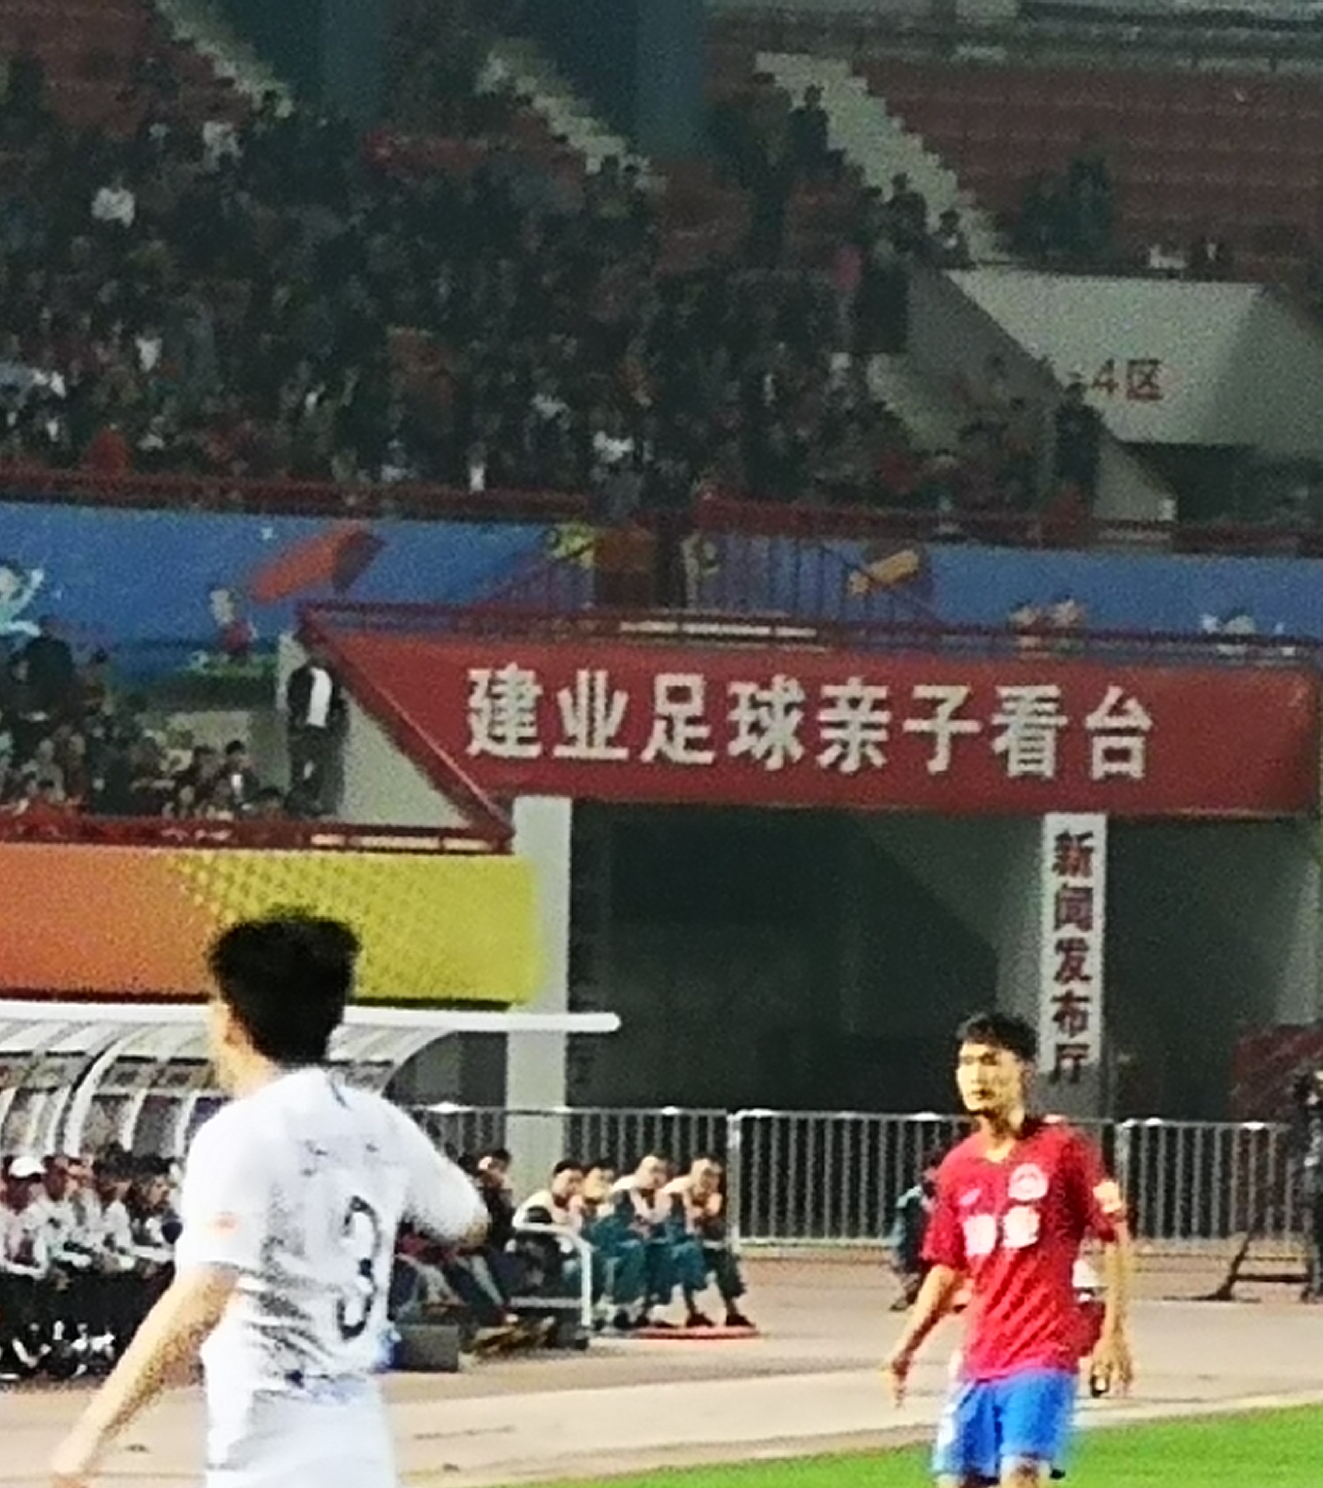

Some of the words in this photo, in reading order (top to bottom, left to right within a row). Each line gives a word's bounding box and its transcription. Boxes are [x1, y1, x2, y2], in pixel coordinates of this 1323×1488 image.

[466, 662, 1155, 780] 建业足球亲子看台
[1052, 829, 1096, 1084] 新闻发布厅
[336, 1196, 383, 1341] 3
